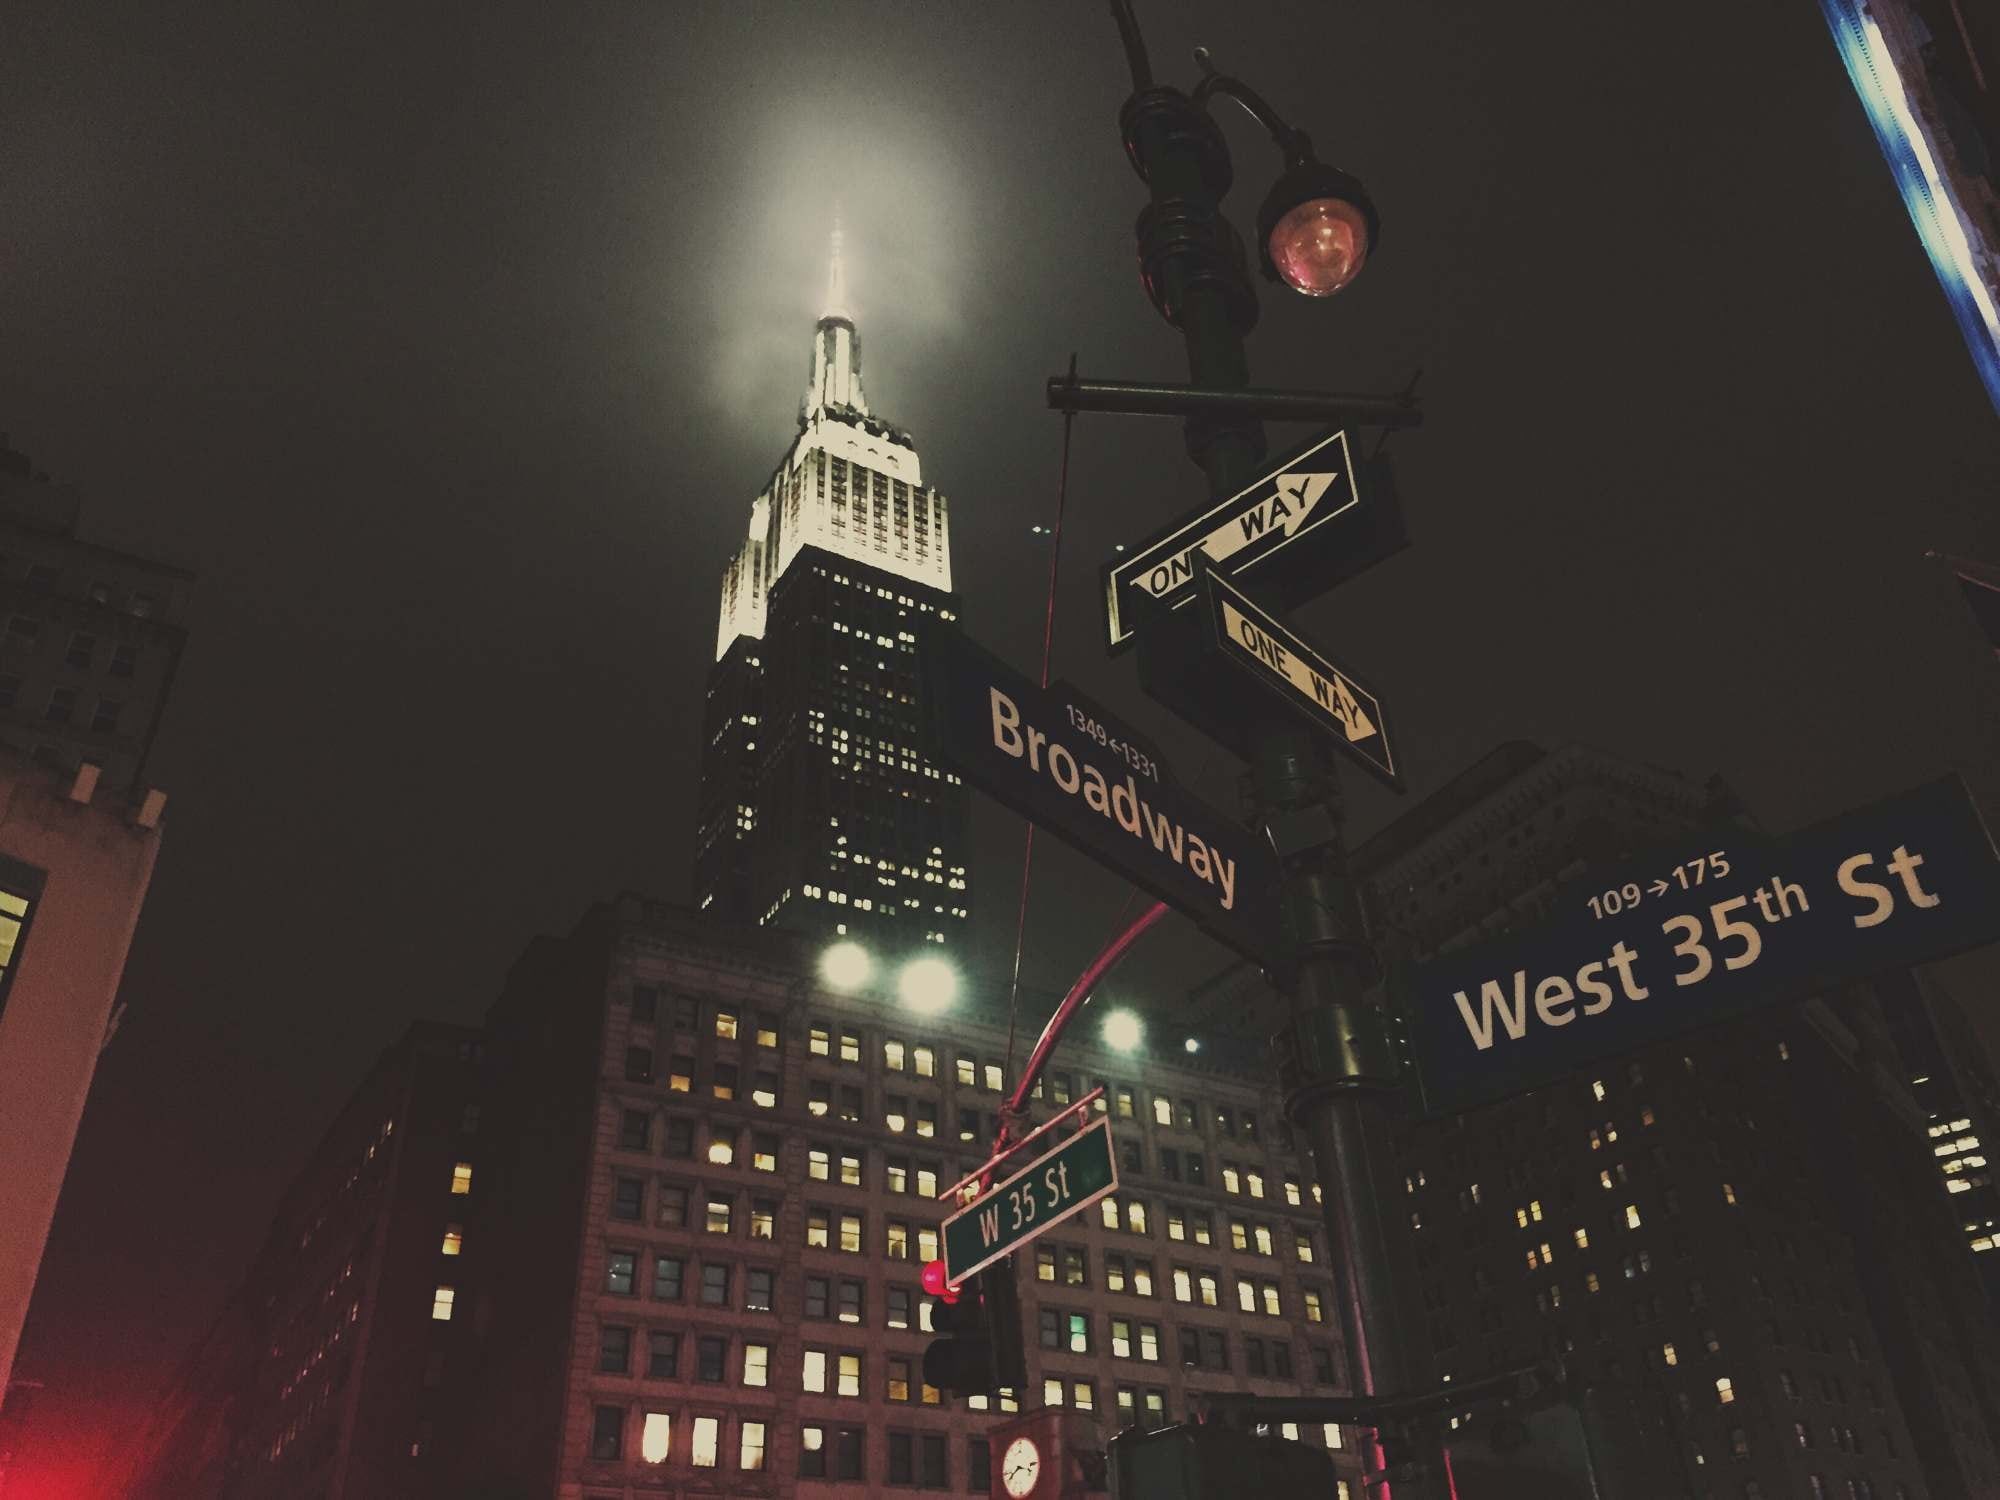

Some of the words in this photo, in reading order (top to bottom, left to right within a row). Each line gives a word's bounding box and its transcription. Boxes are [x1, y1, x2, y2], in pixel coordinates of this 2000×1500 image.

[1150, 543, 1203, 594] ON
[1240, 477, 1311, 541] WAY
[1241, 619, 1291, 679] ONE
[1310, 671, 1358, 729] WAY
[989, 685, 1236, 910] Broadway
[1066, 704, 1107, 748] 1349
[1121, 742, 1159, 783] 1331
[1587, 882, 1642, 920] 109
[1672, 850, 1732, 891] 175
[1453, 940, 1650, 1052] West
[1661, 875, 1811, 987] 35th
[1836, 844, 1942, 929] St
[979, 1203, 999, 1248] W
[1008, 1181, 1036, 1231] 35
[1045, 1160, 1071, 1208] St
